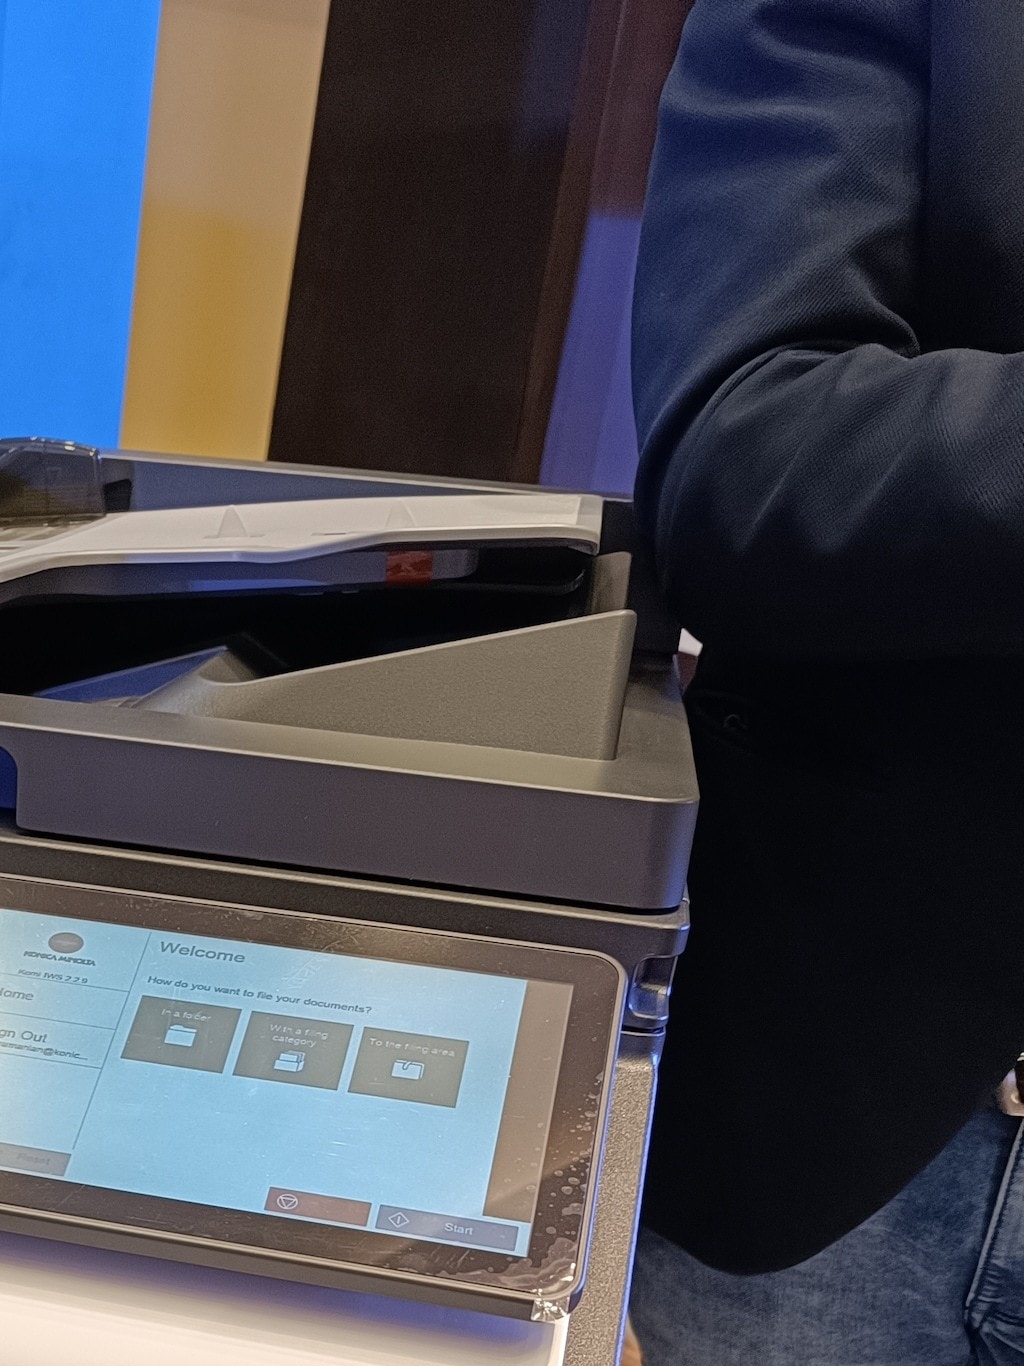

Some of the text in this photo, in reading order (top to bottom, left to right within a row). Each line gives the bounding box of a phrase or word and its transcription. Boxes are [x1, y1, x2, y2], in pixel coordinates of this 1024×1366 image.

[23, 950, 96, 967] KONICA MINOLTA
[161, 941, 246, 963] Welcome
[147, 975, 373, 1014] How do you want to file your documents?
[173, 1010, 181, 1018] a
[182, 1011, 212, 1022] folder
[20, 1030, 49, 1043] Out
[294, 1028, 303, 1036] a
[271, 1034, 317, 1048] category
[369, 1037, 383, 1048] To
[384, 1040, 402, 1050] the
[430, 1047, 456, 1058] area
[444, 1222, 474, 1236] Start
